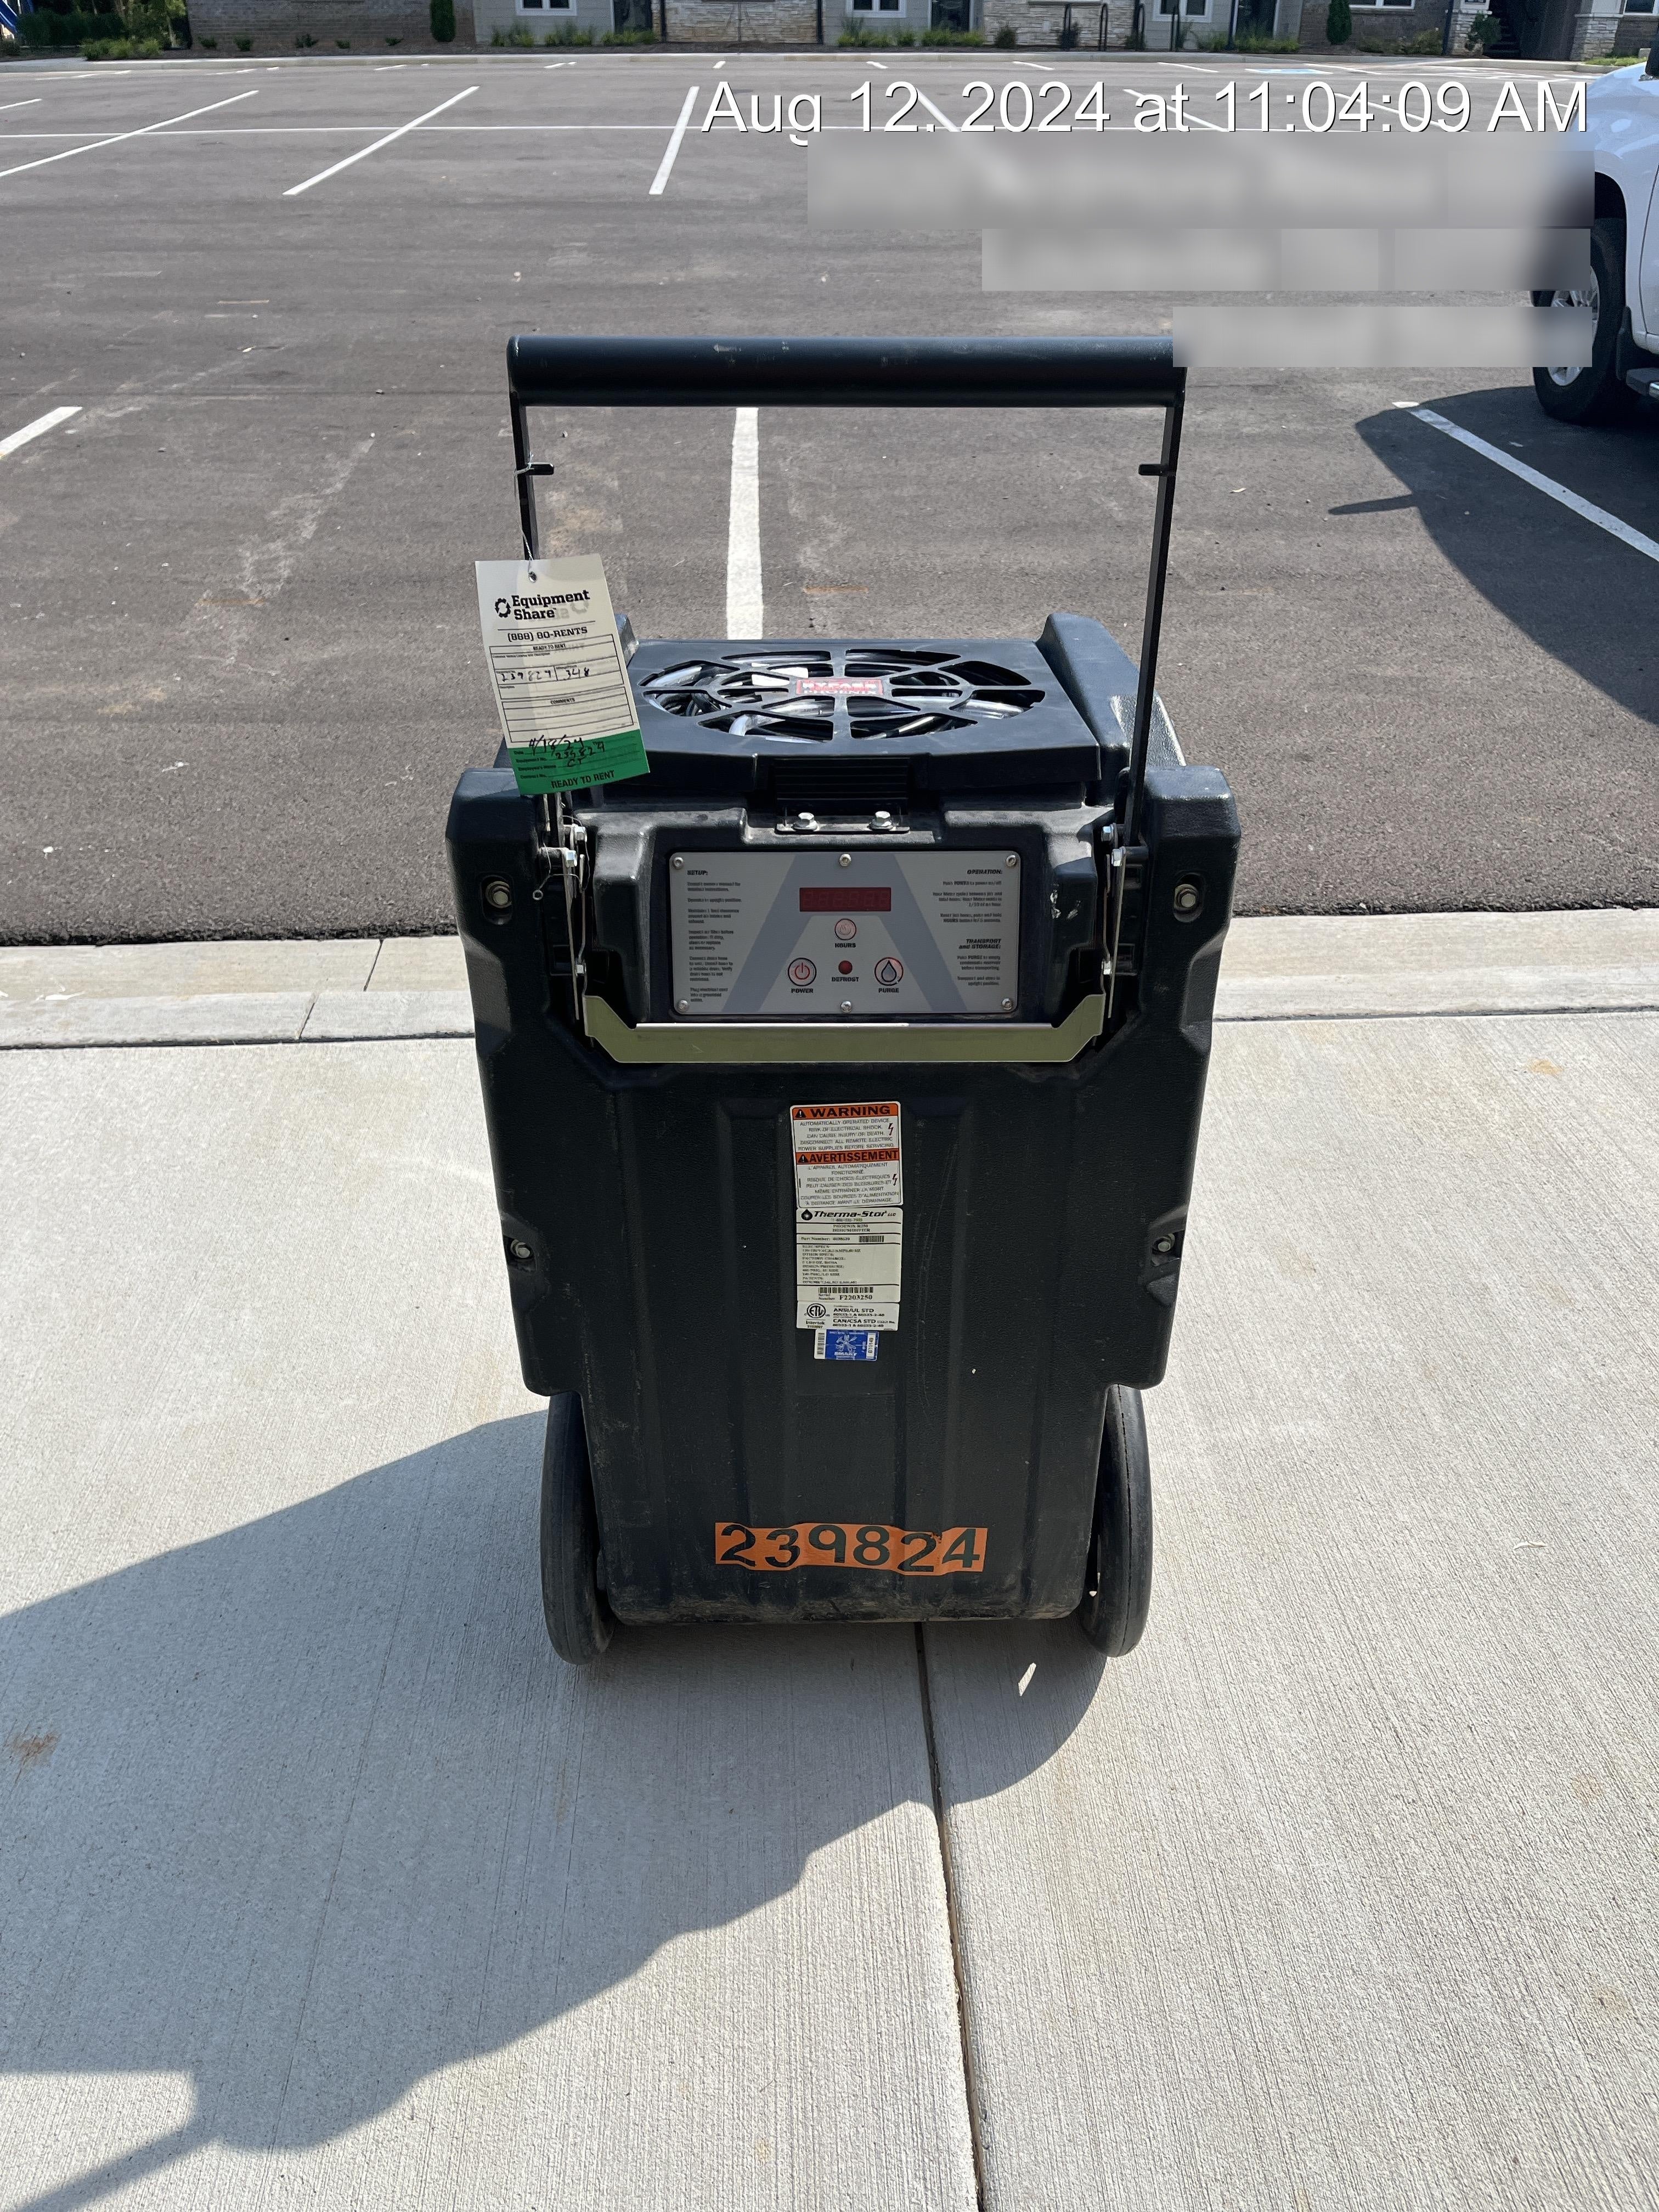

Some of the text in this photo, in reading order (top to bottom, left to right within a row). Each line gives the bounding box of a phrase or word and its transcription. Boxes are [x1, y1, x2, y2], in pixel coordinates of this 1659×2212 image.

[511, 589, 591, 609] Equipment
[514, 608, 556, 620] Share
[508, 627, 588, 642] (888) 80-RENTS
[551, 770, 615, 789] READY TO RENT
[810, 1105, 890, 1118] WARNING
[809, 1150, 898, 1163] AVERTISSEMENT
[809, 1305, 825, 1317] ETL
[720, 1524, 980, 1572] 239824
